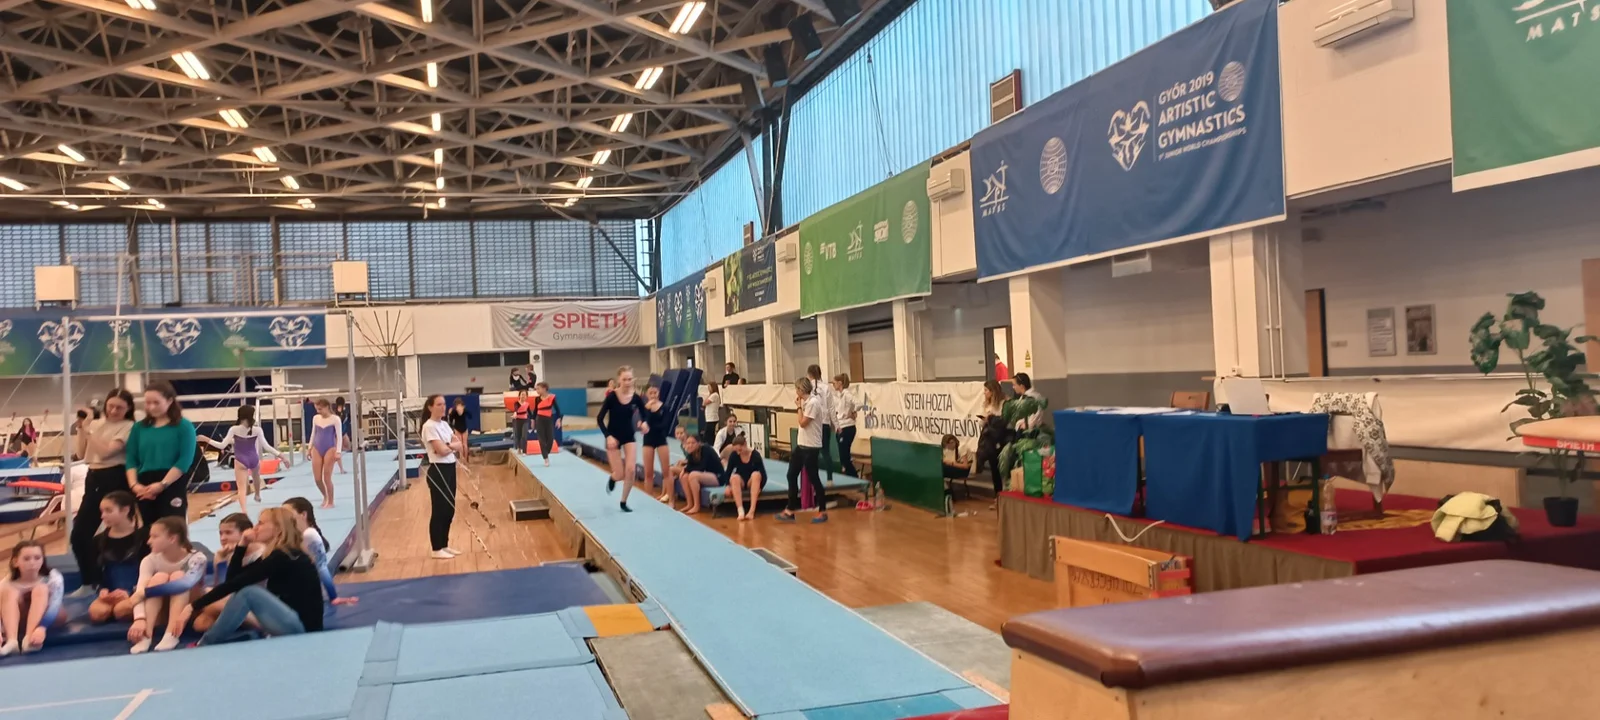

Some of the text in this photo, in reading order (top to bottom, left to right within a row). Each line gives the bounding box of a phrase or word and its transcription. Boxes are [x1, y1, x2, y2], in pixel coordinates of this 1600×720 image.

[1189, 70, 1214, 93] 2019
[1158, 90, 1216, 127] ARTISTIC
[1158, 104, 1246, 148] GYMNASTICS
[552, 312, 628, 329] SPIETH
[904, 392, 953, 411] ISTEN HOZTA
[880, 413, 886, 429] A
[886, 414, 902, 431] KIDS
[902, 414, 924, 433] KUPA
